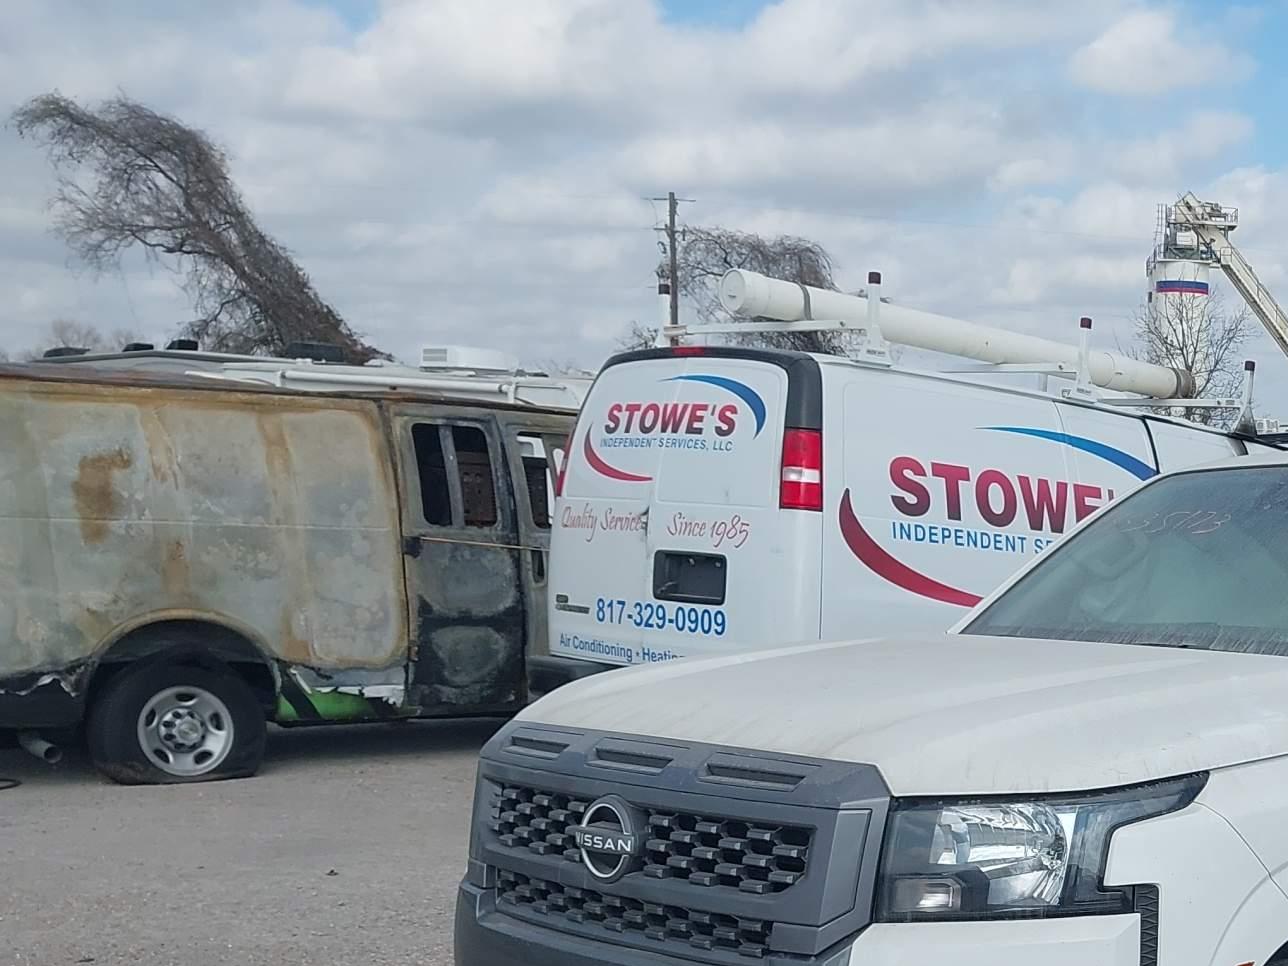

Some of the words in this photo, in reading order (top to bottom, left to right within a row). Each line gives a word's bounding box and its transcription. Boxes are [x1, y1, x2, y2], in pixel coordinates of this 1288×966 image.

[604, 403, 738, 437] STOWE'S
[658, 437, 710, 451] SERVICES,
[713, 441, 733, 452] LLC
[561, 502, 598, 542] Quality
[667, 511, 706, 537] Since
[710, 514, 750, 548] 1985
[892, 522, 1026, 554] INDEPENDENT
[596, 598, 726, 636] 817-329-0909
[560, 633, 571, 647] Air
[572, 635, 632, 662] Conditioning
[642, 648, 686, 662] Heati
[576, 832, 632, 852] NISSAN
